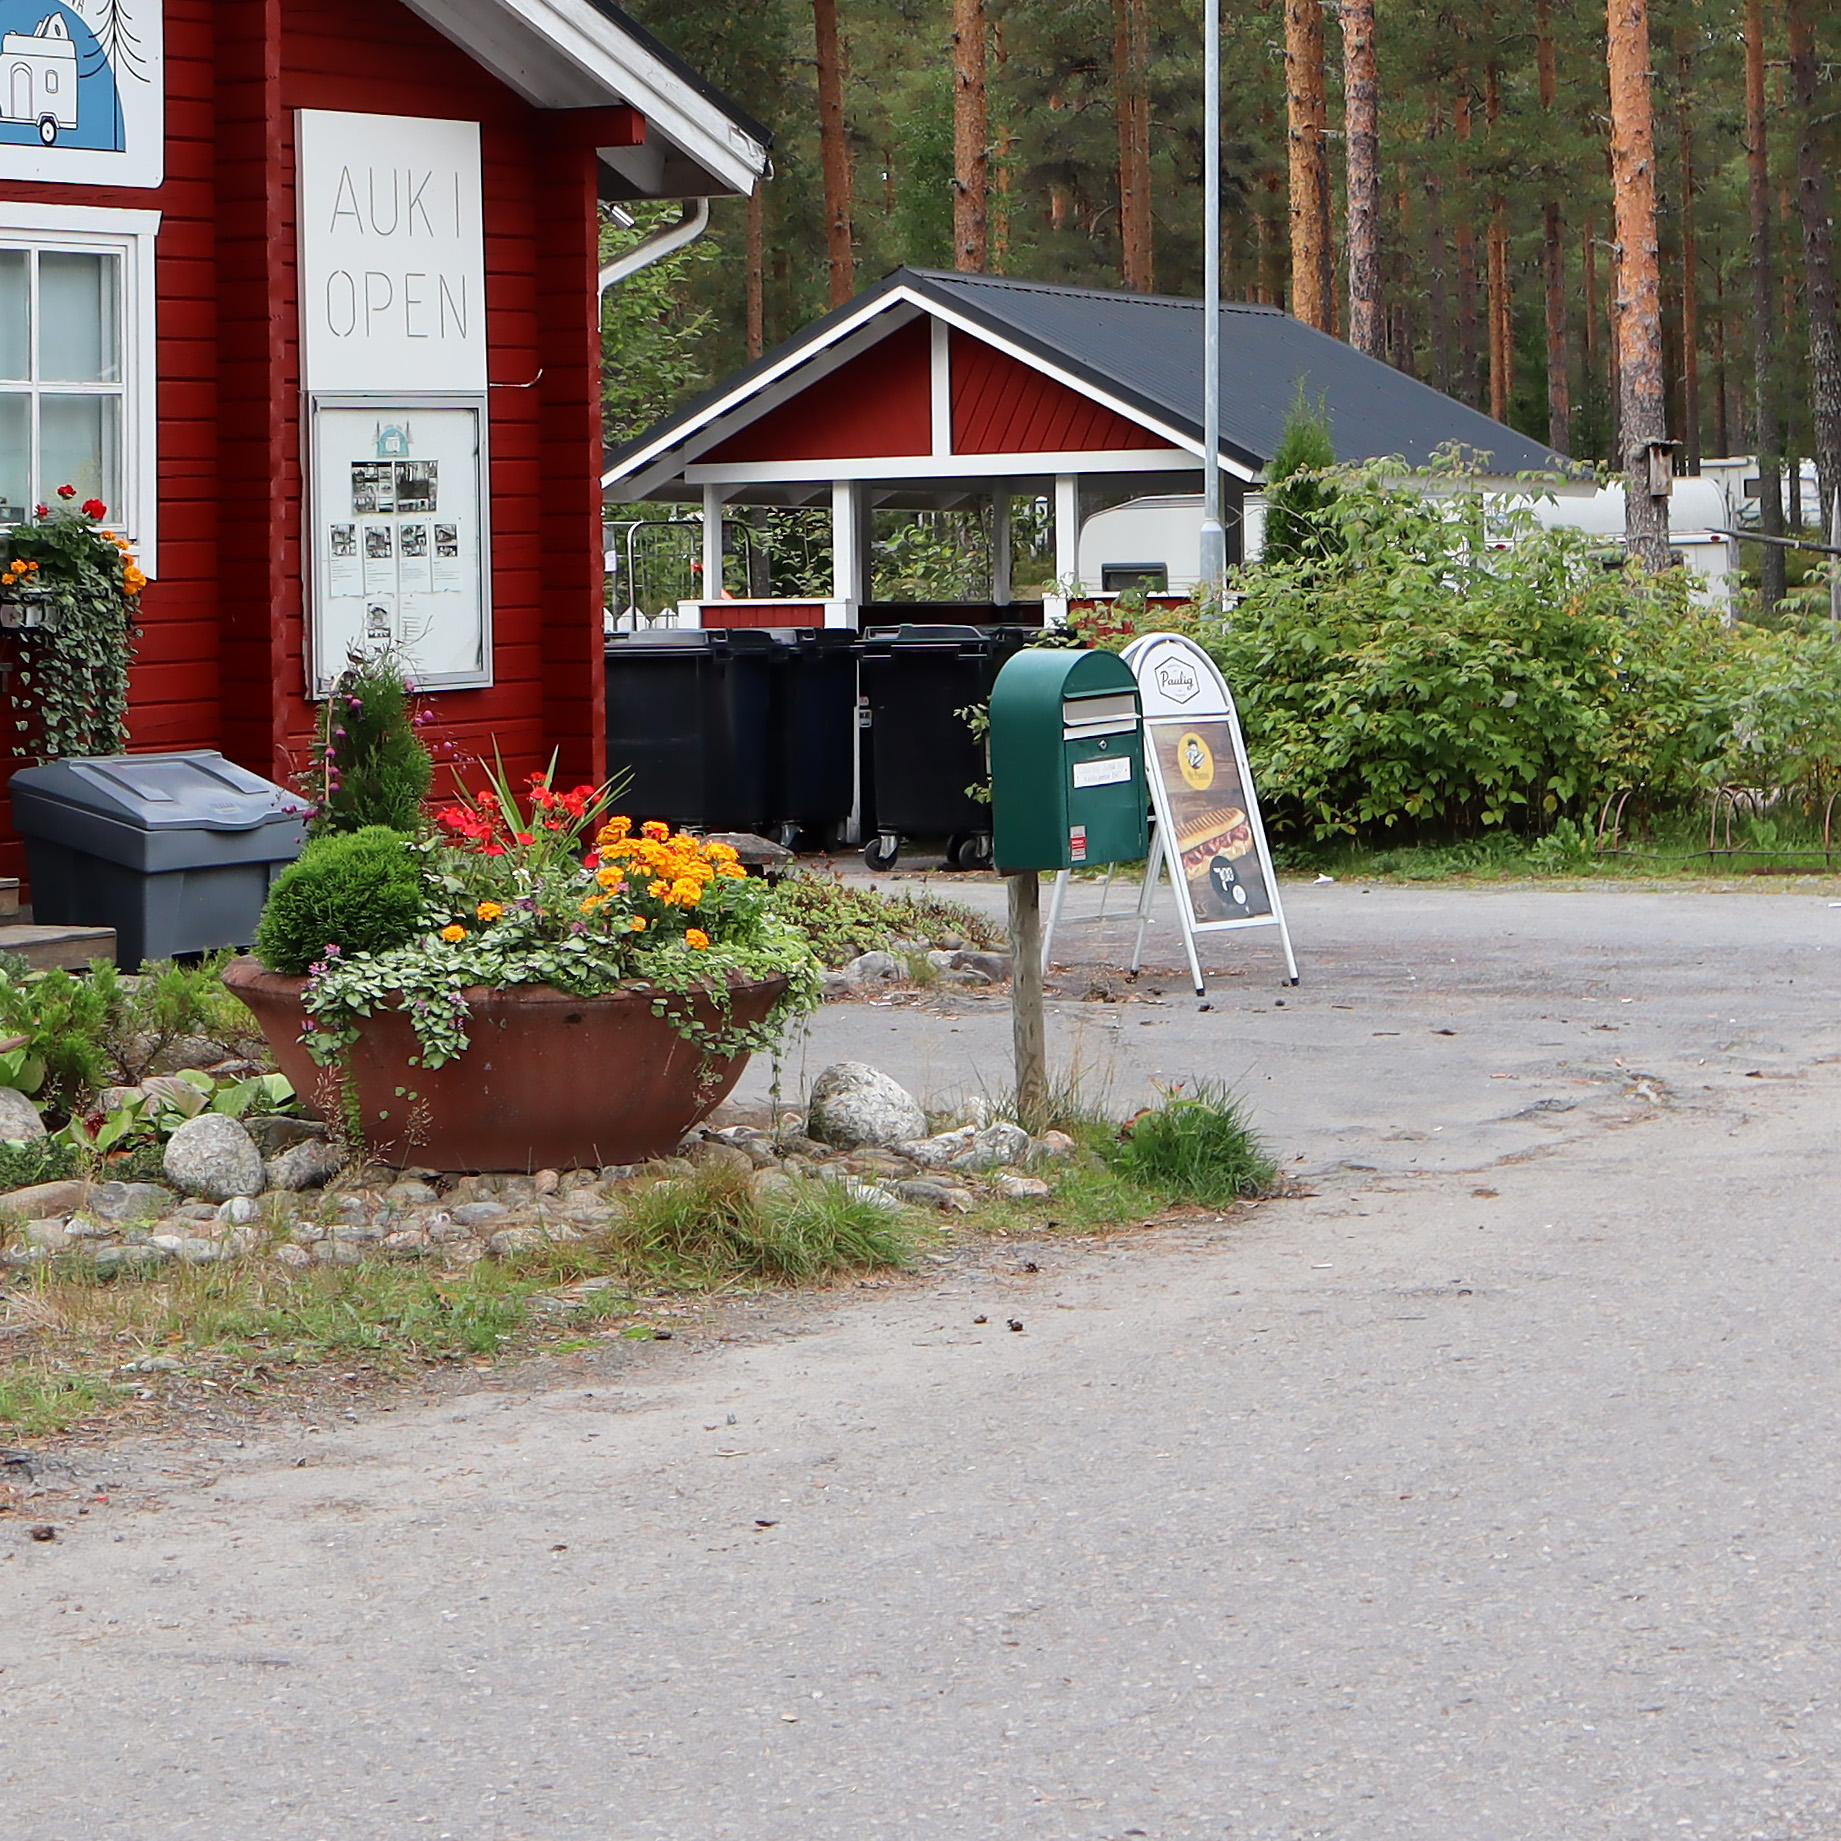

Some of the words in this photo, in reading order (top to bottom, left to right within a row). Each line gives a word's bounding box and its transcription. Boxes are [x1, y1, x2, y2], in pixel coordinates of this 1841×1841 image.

[330, 165, 460, 239] AUKI
[327, 270, 467, 339] OPEN
[1160, 670, 1194, 691] Paulig
